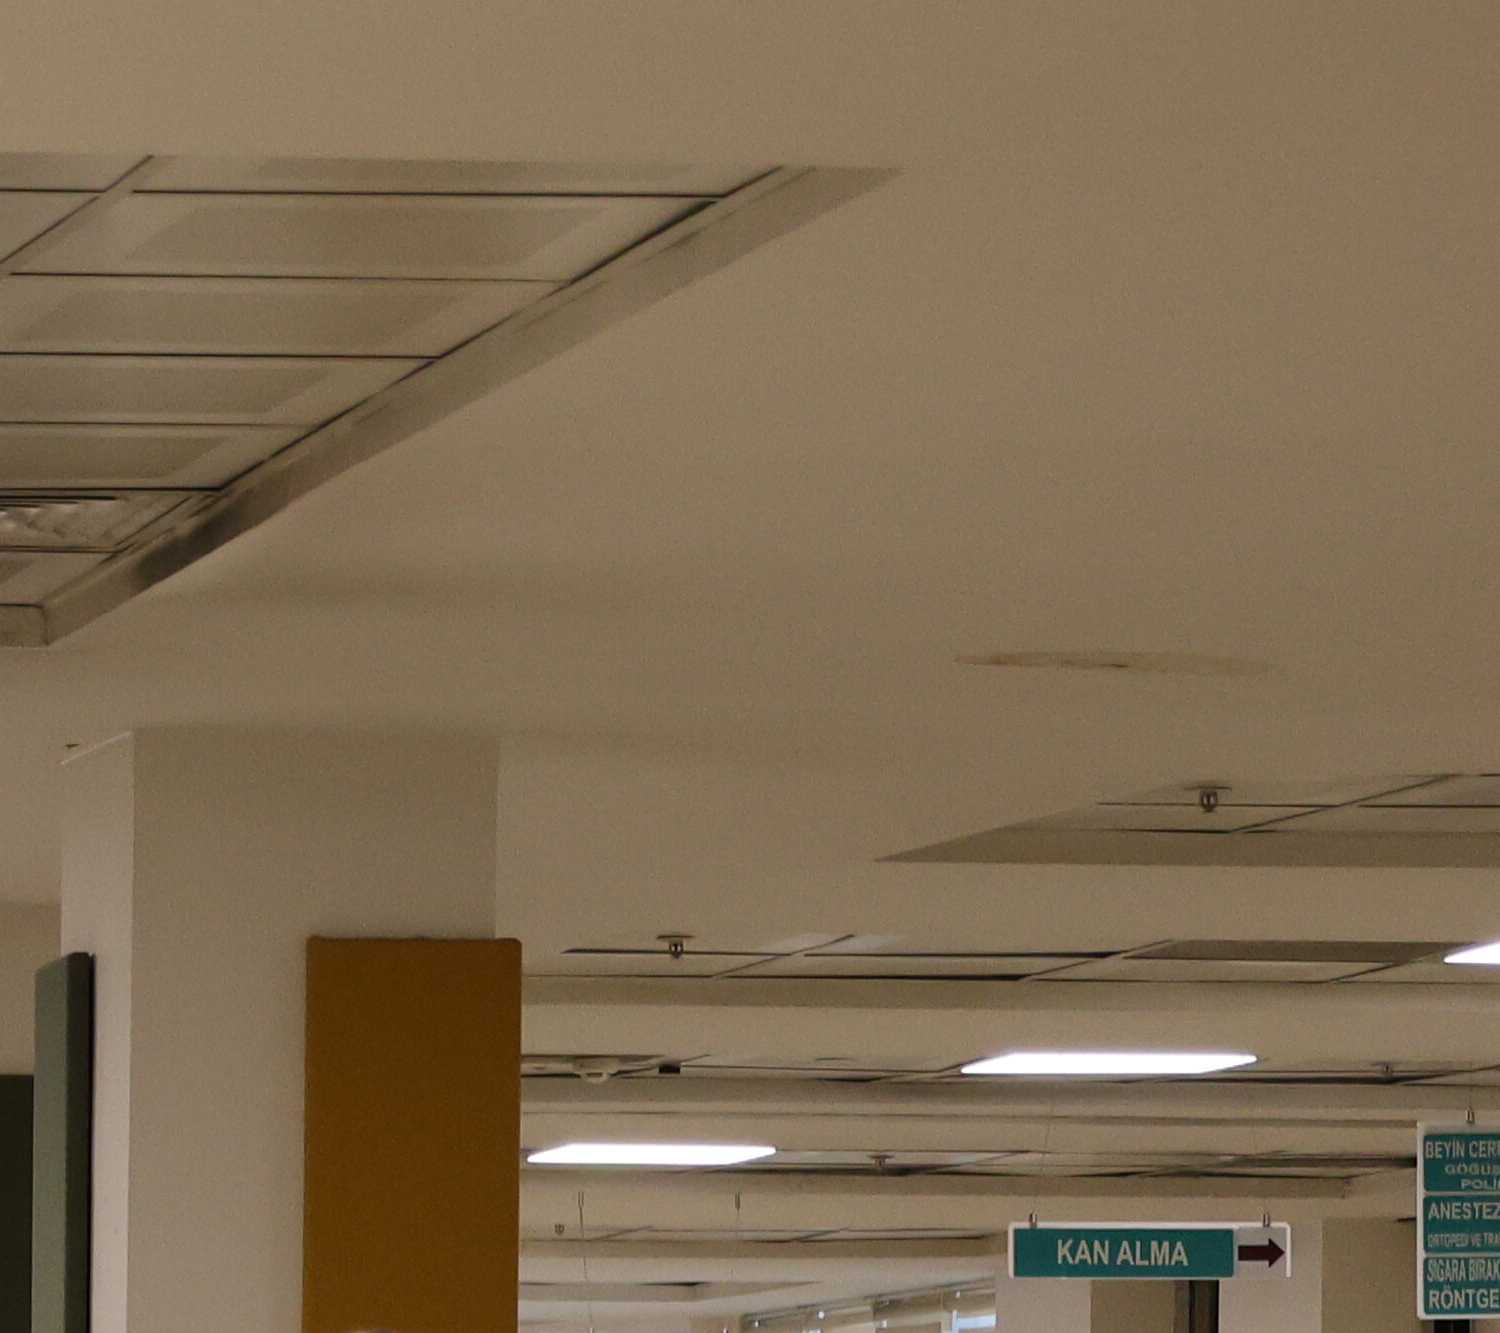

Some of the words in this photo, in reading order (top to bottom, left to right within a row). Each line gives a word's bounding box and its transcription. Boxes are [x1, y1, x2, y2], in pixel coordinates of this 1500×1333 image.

[1460, 1176, 1500, 1191] POLİ
[1056, 1238, 1110, 1266] KAN
[1116, 1239, 1190, 1267] ALMA
[1428, 1284, 1500, 1310] RÖNTGE
